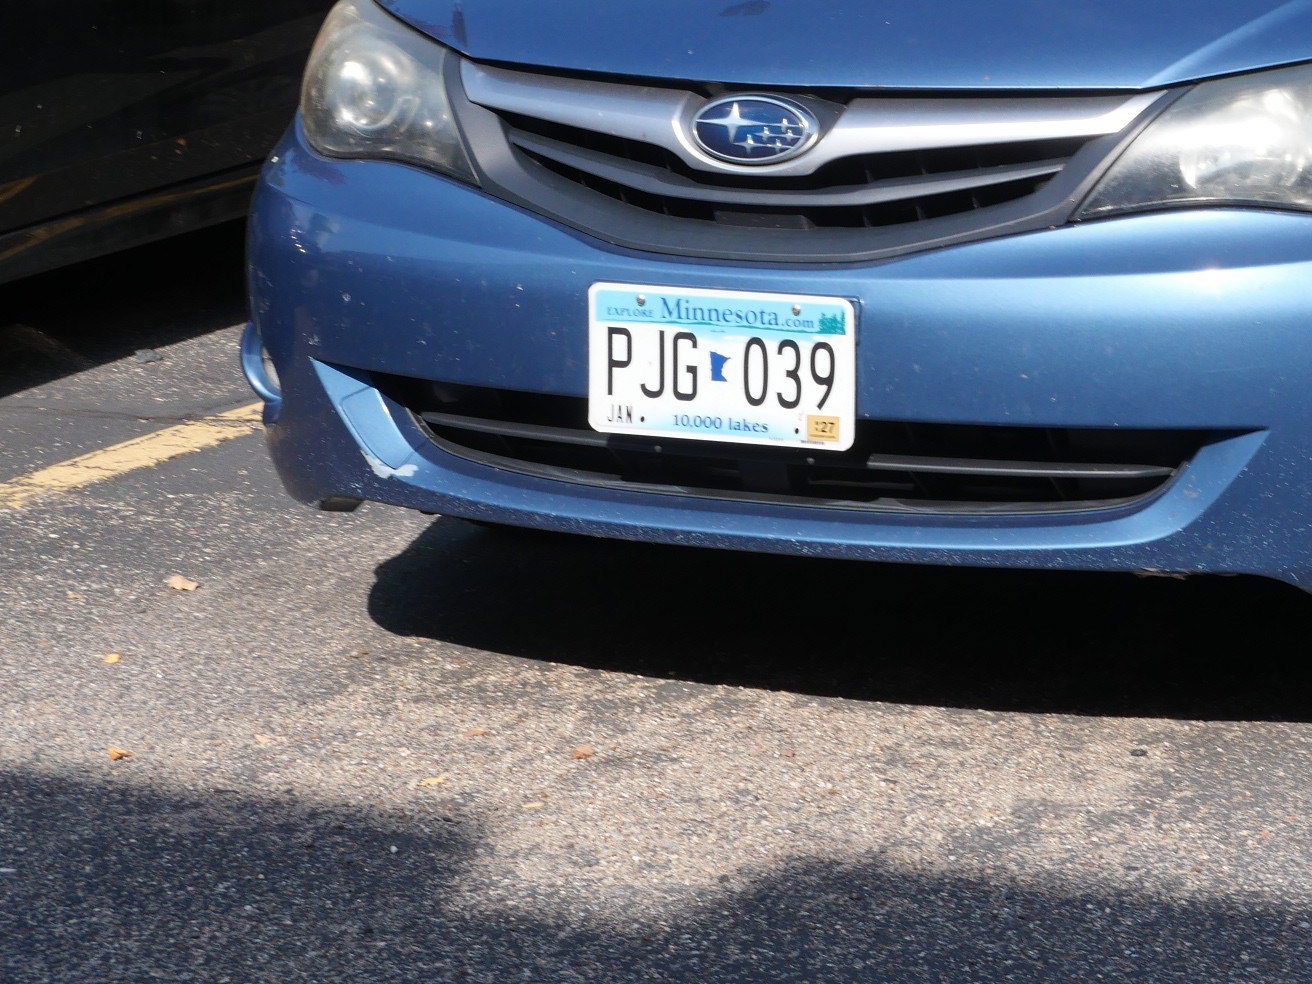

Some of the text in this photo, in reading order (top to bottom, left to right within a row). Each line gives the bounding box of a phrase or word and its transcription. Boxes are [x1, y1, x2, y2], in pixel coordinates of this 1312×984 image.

[607, 306, 655, 318] EXPLORE
[607, 326, 836, 410] PJG 039
[607, 404, 633, 424] JAN
[728, 415, 769, 434] lakes
